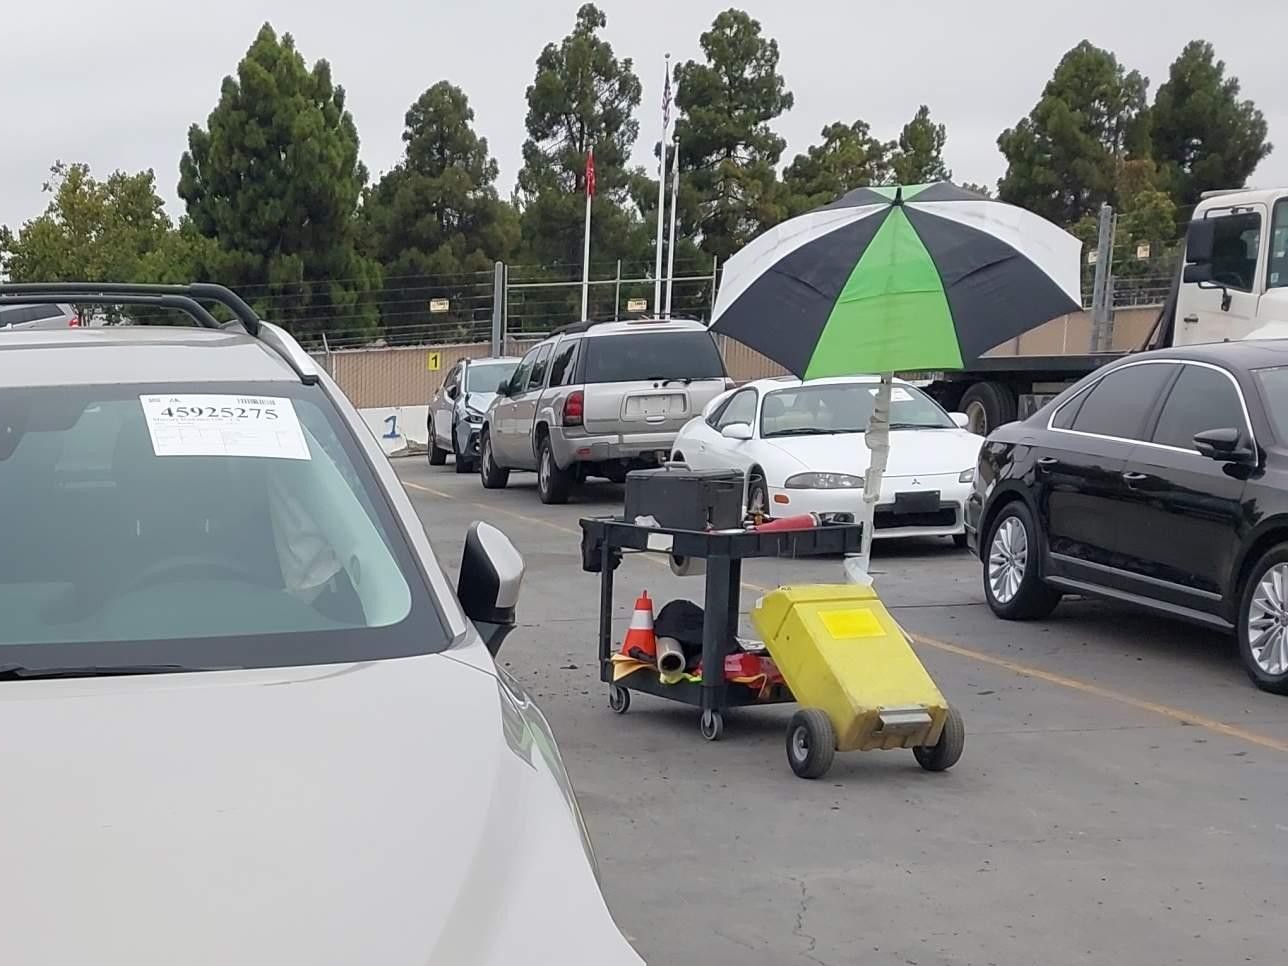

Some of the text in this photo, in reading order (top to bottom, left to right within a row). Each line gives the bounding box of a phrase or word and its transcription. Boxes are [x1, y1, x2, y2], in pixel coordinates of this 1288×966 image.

[430, 355, 439, 369] 1
[160, 406, 279, 420] 45925275
[382, 415, 401, 439] 1
